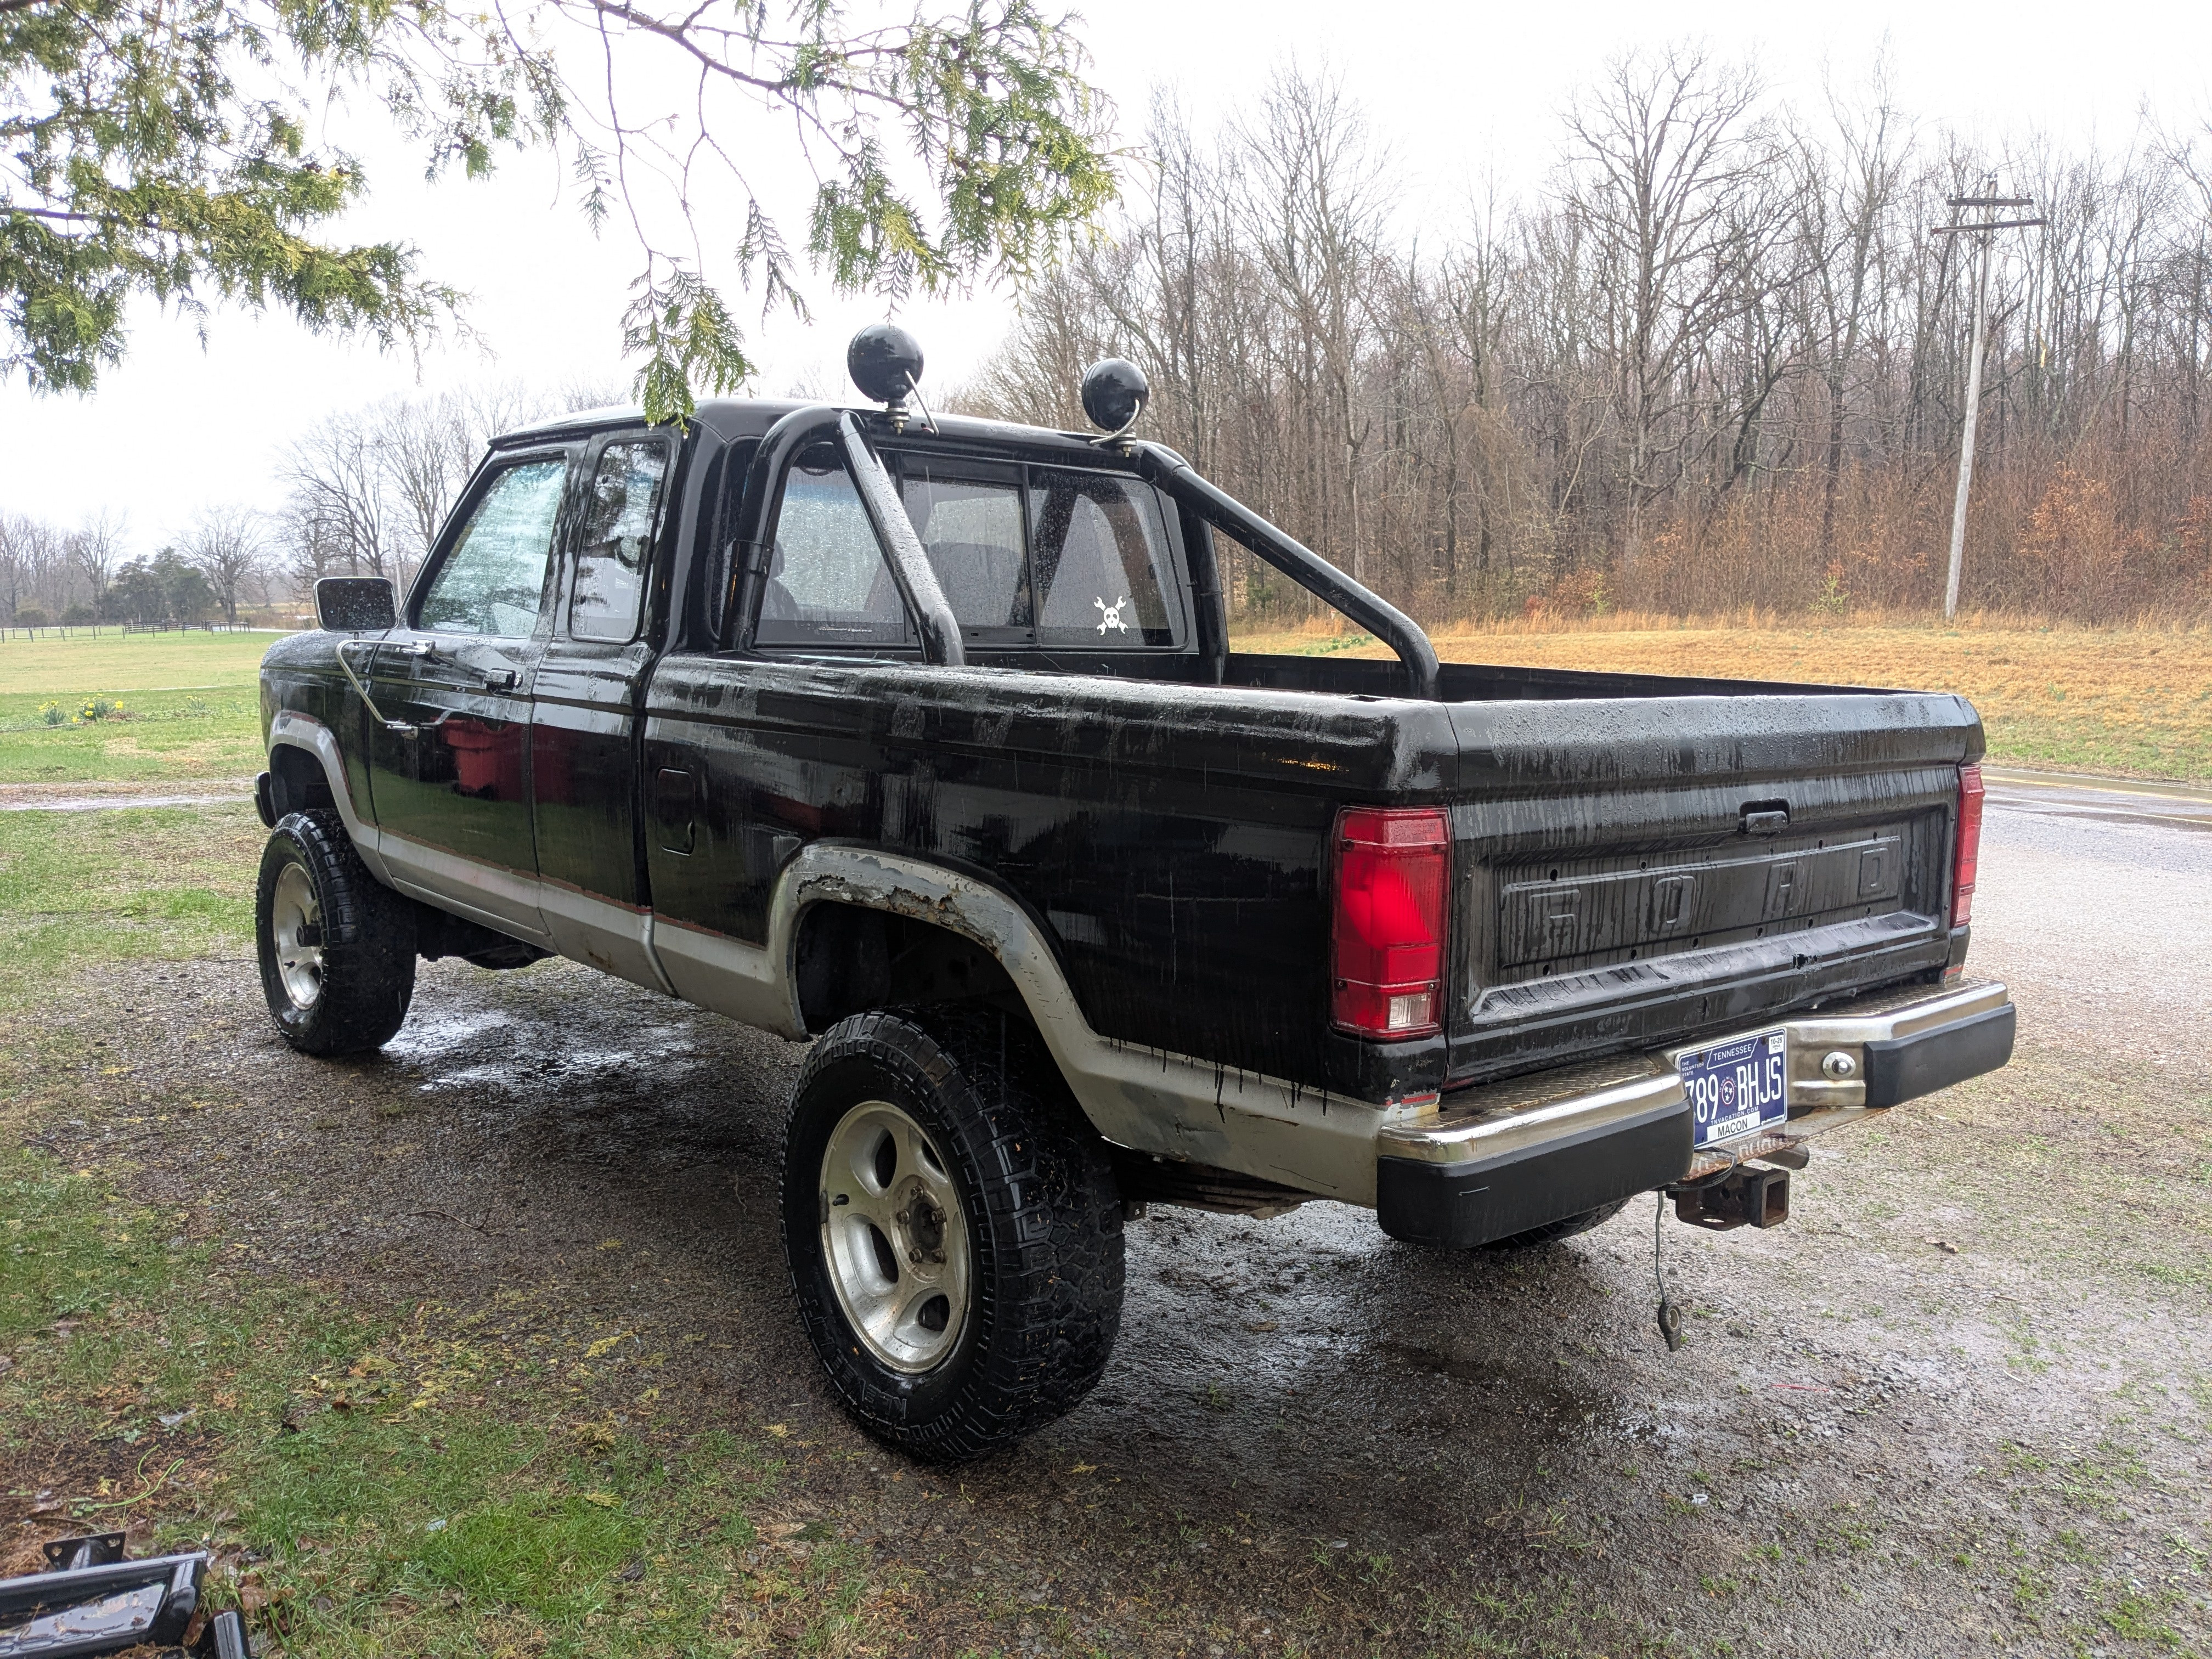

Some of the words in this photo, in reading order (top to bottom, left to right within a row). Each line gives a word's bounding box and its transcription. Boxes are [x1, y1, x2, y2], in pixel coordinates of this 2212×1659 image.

[1714, 1043, 1752, 1061] TENNESSEE
[1682, 1062, 1704, 1071] VOLUNTEER
[1736, 1056, 1782, 1111] BHJS
[1711, 1106, 1759, 1125] TNVACATION.COM
[1718, 1118, 1747, 1137] MACON
